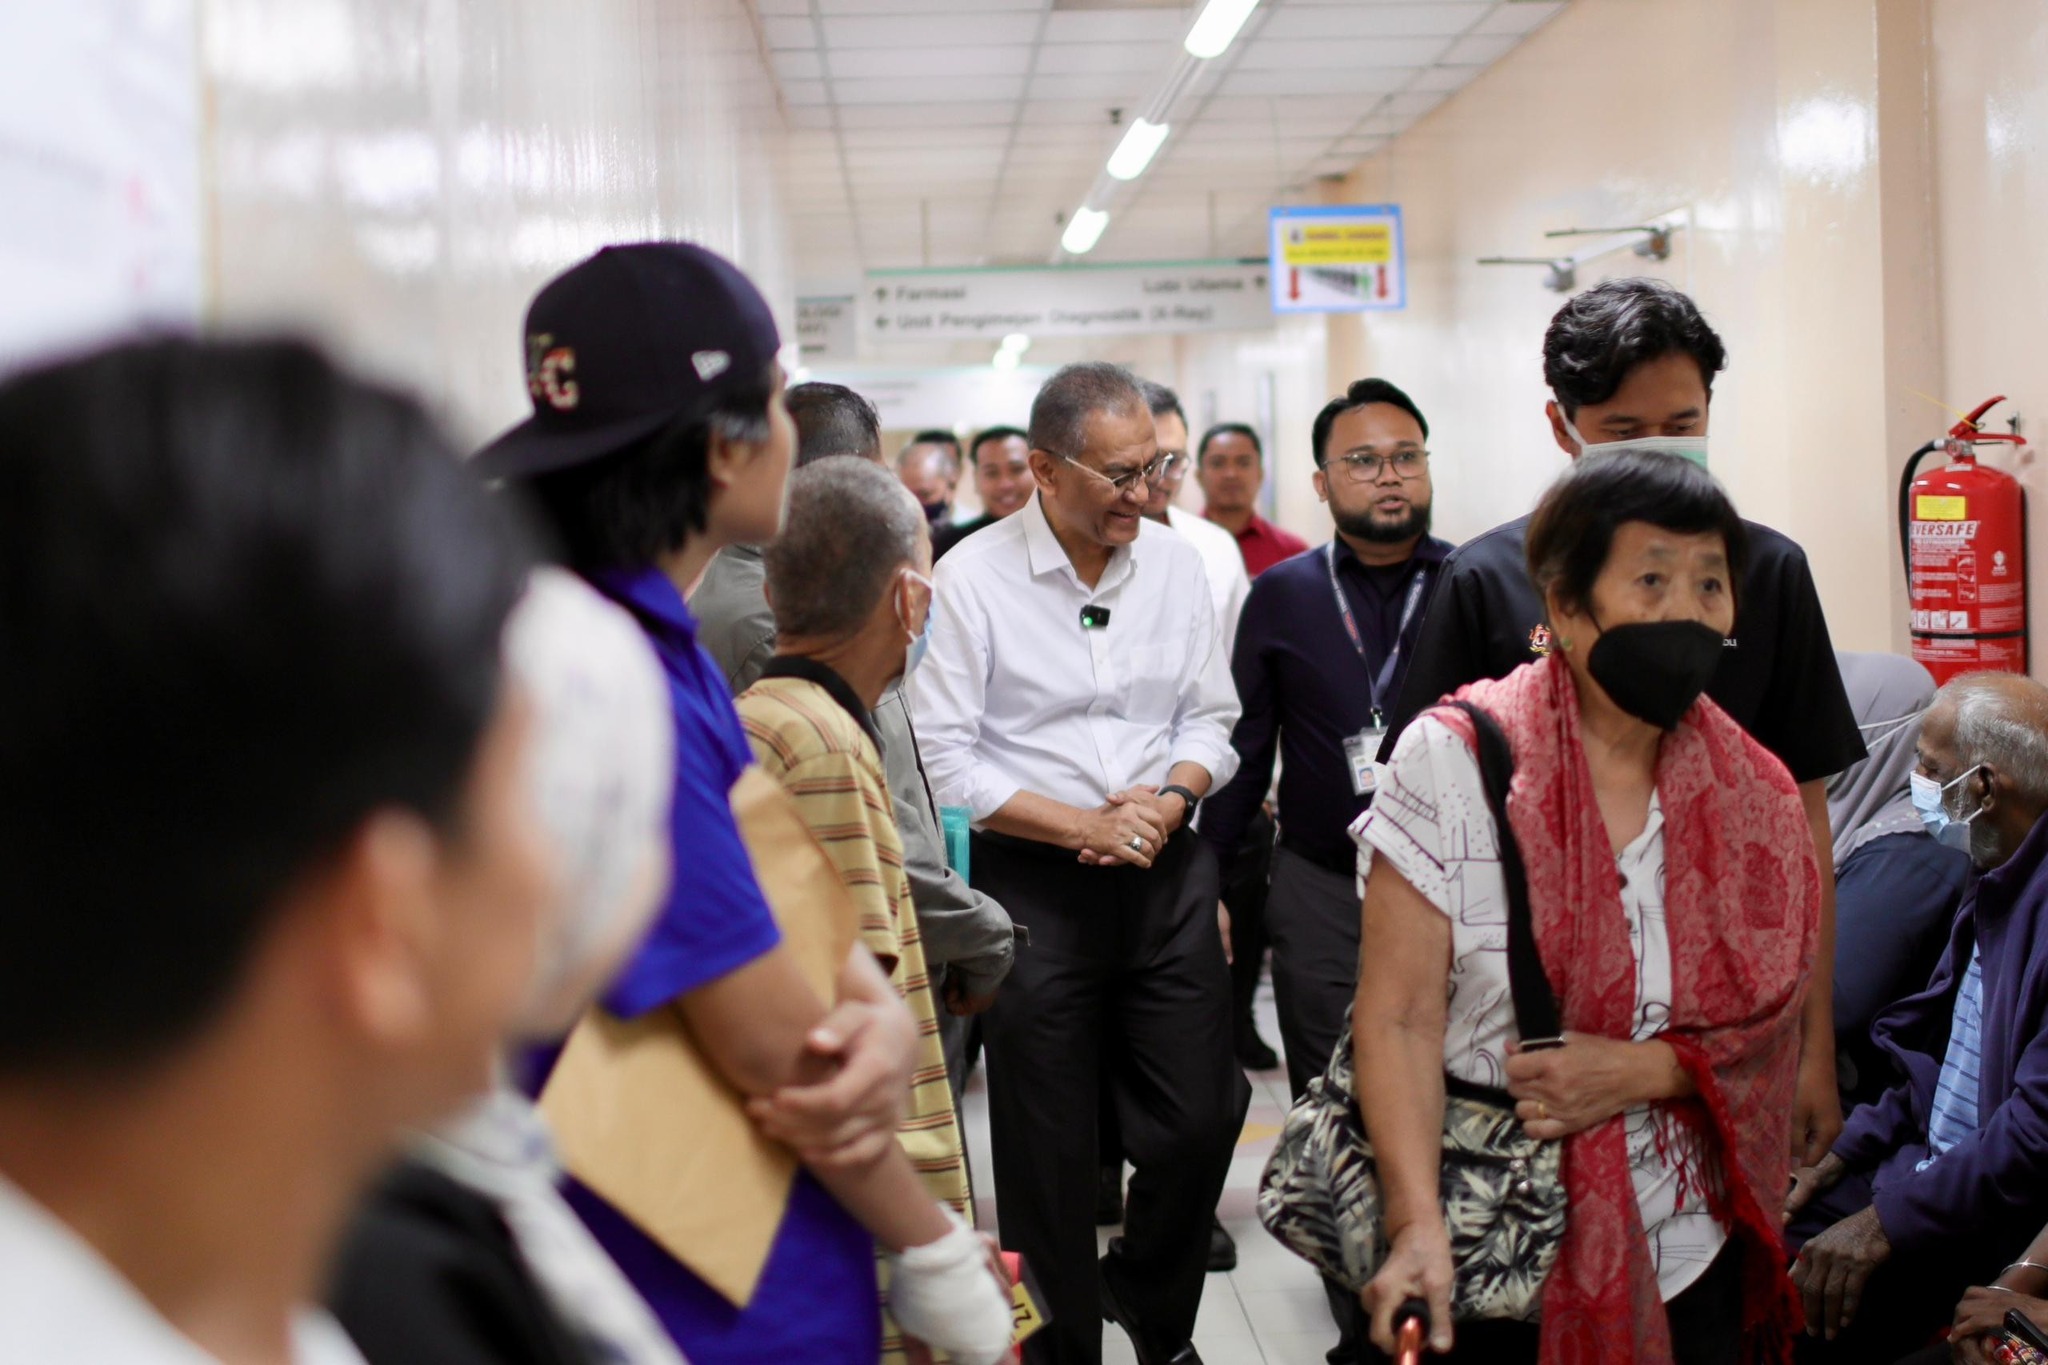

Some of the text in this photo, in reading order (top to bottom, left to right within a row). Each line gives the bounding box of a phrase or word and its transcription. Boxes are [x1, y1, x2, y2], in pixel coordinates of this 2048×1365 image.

[1188, 277, 1243, 291] Utama
[897, 286, 965, 300] Farmasi
[898, 315, 932, 328] Unit
